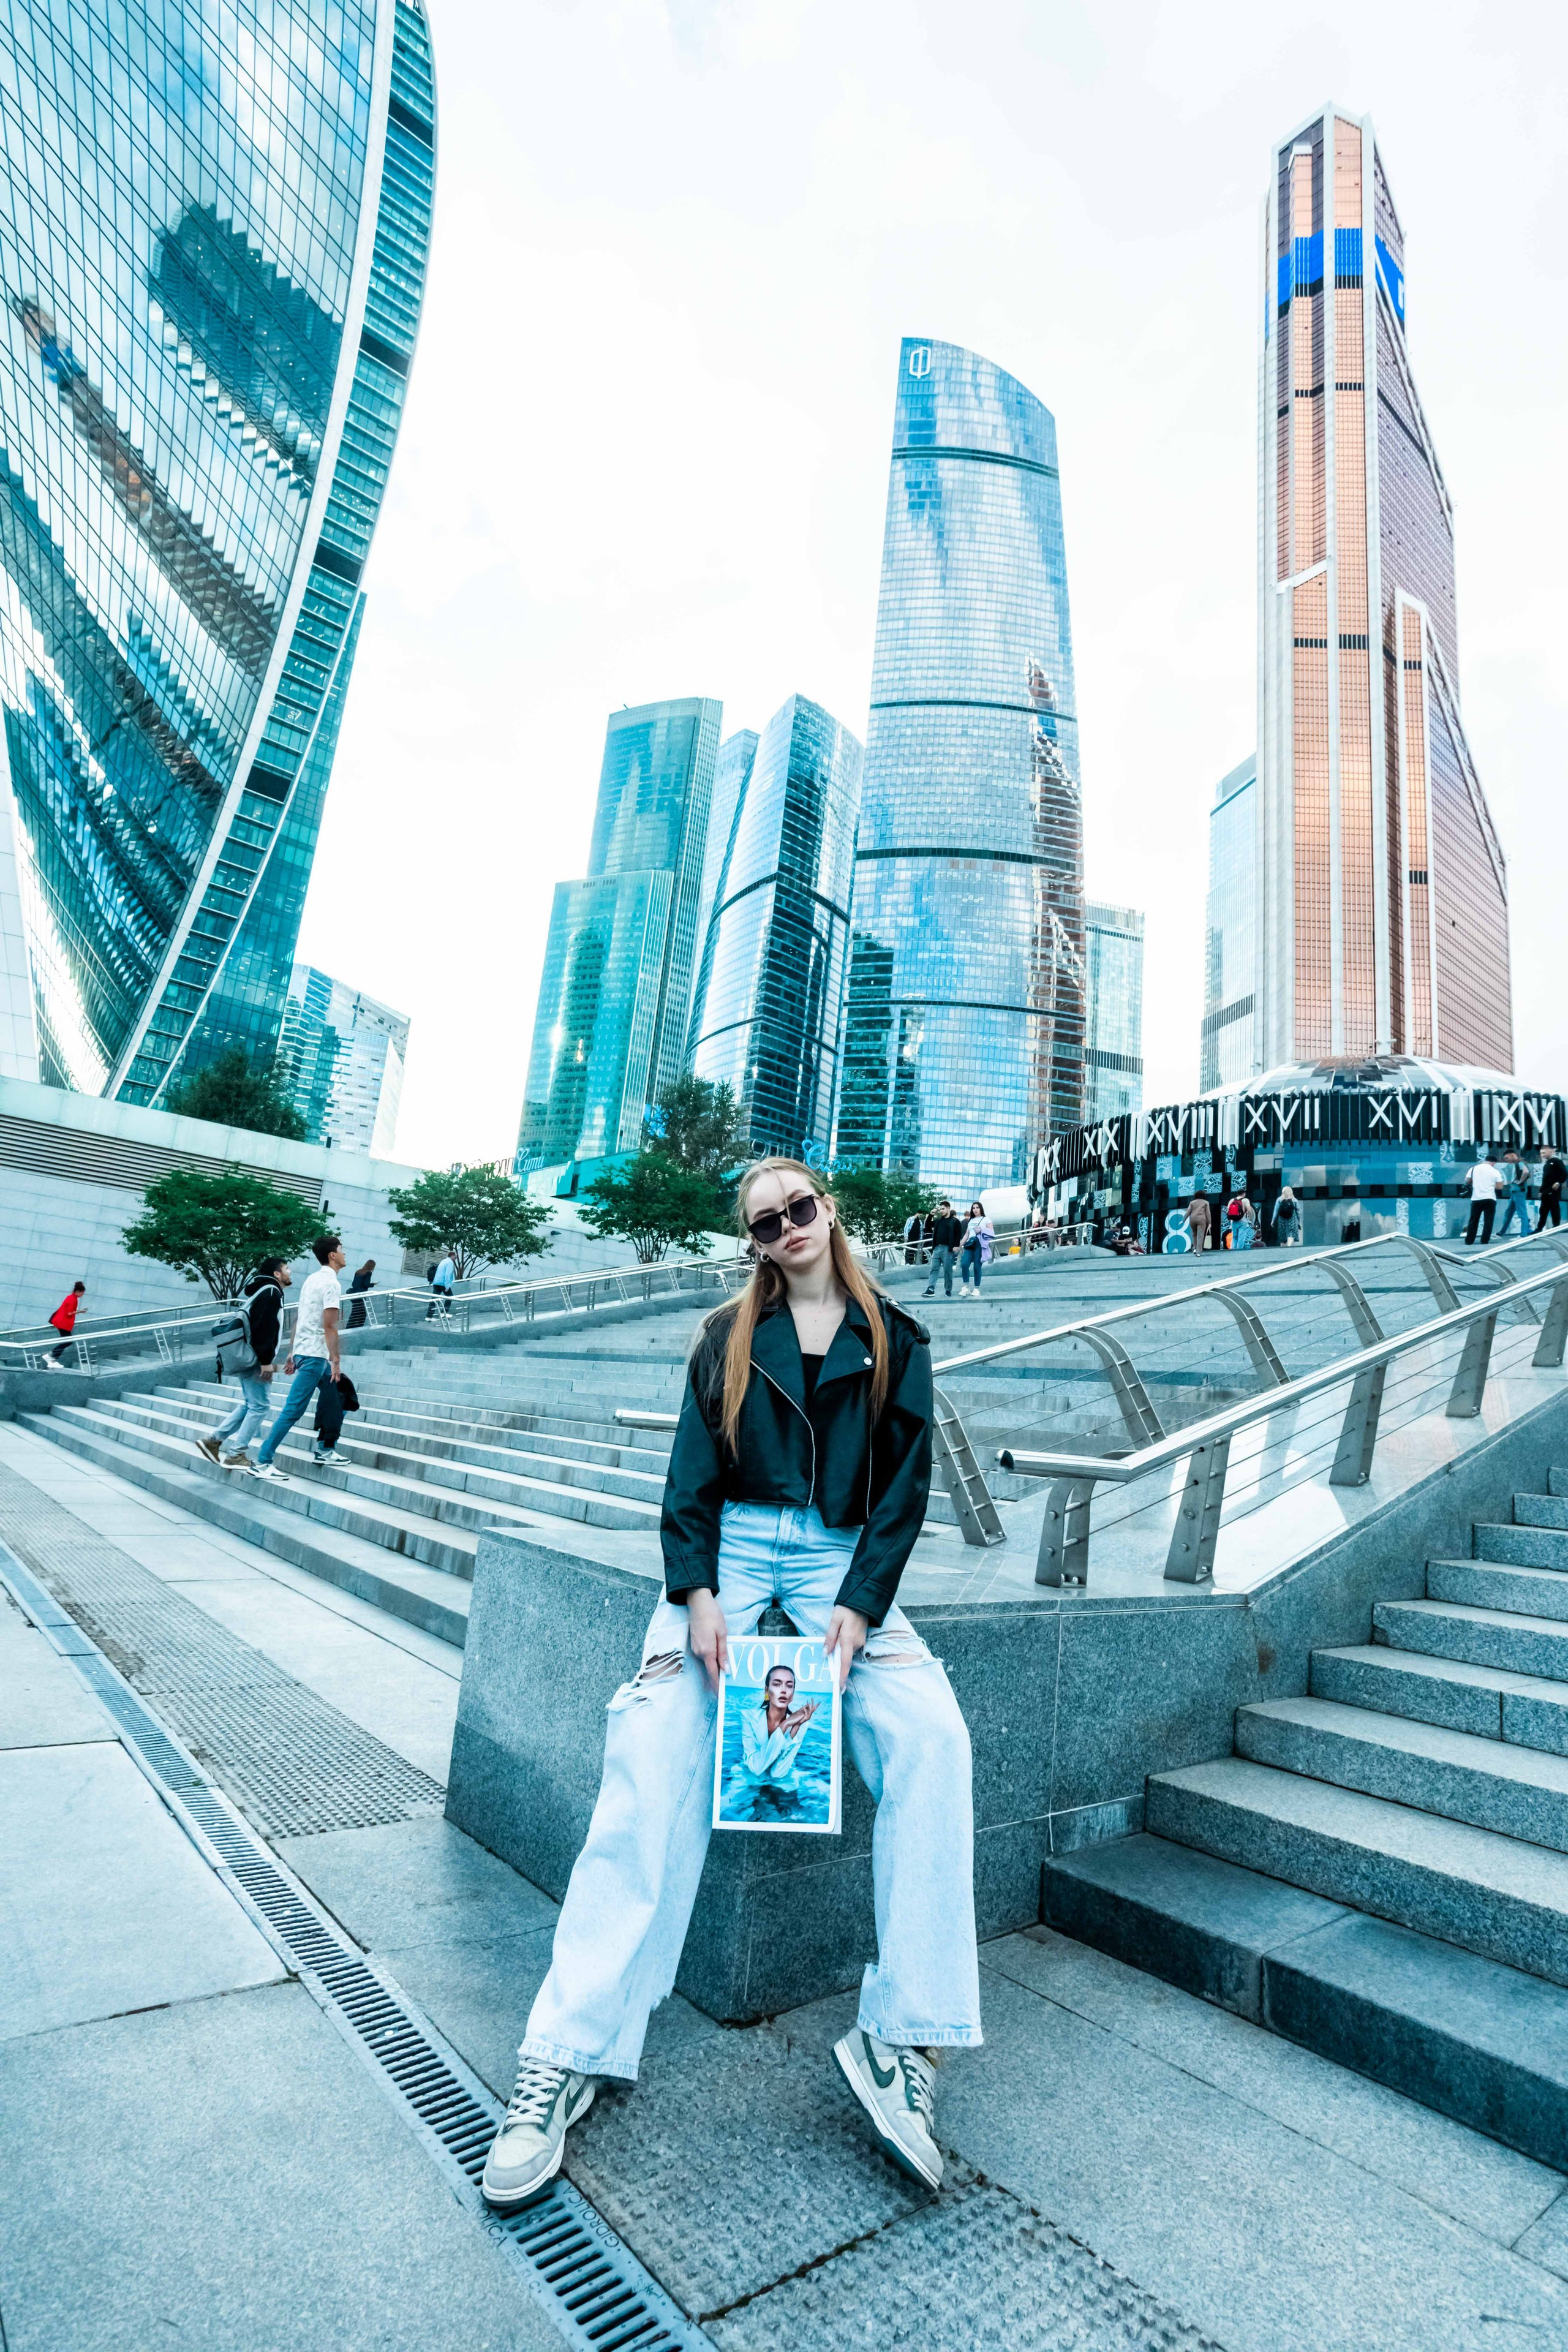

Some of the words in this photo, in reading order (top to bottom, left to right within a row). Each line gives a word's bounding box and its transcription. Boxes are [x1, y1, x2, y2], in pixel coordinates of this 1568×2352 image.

[1084, 1123, 1119, 1159] XIX
[1146, 1107, 1213, 1145] XVIII
[1245, 1098, 1319, 1133] XVII
[1368, 1096, 1437, 1128] XVI
[1496, 1099, 1555, 1133] XV
[563, 2185, 619, 2247] GIDROLICA
